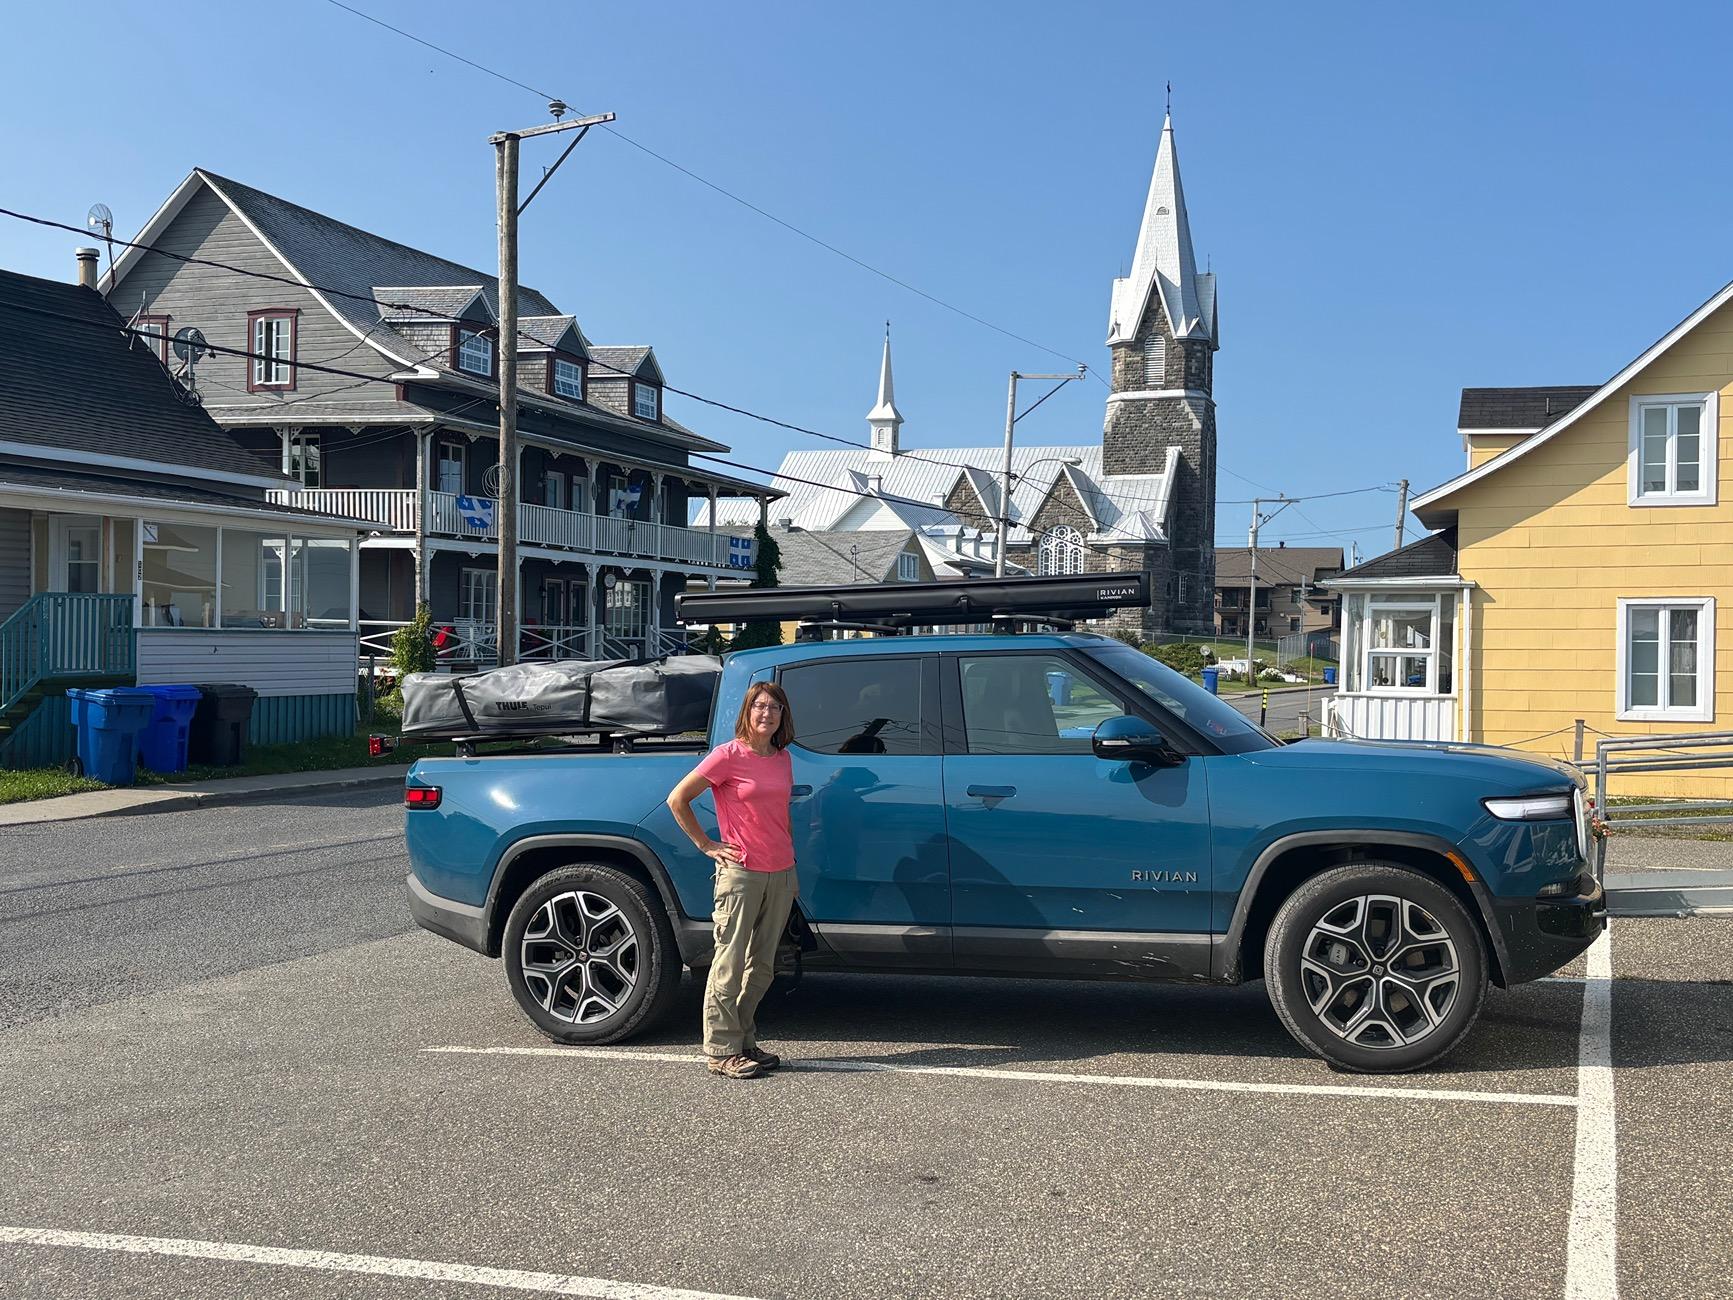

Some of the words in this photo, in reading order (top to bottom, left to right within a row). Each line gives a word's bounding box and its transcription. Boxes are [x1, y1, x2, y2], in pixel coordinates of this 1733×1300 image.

[1100, 588, 1135, 596] RIVIAN
[495, 701, 529, 711] THULE
[1131, 869, 1198, 882] RIVIAN
